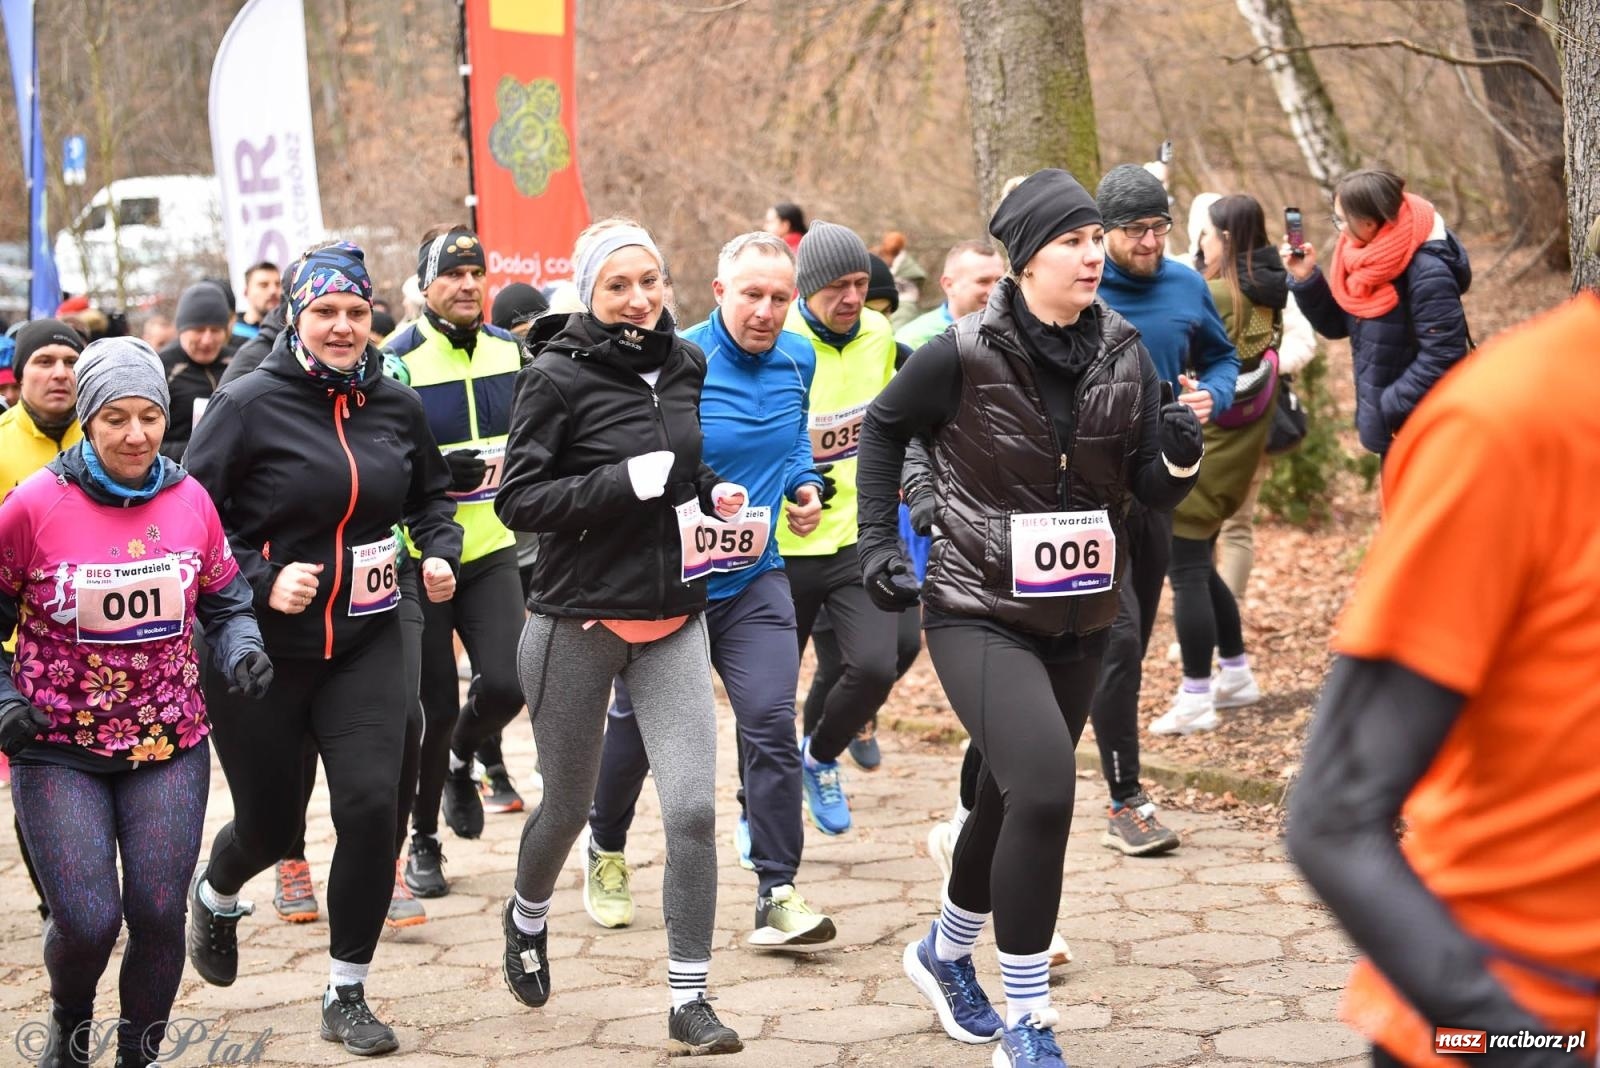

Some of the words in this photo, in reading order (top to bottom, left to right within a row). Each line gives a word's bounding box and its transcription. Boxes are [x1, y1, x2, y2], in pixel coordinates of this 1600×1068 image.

[545, 257, 574, 274] co
[618, 339, 642, 351] adidas
[821, 423, 863, 450] 035
[1022, 517, 1048, 527] BIEG
[360, 547, 377, 558] BIEG
[1034, 539, 1100, 571] 006
[86, 569, 112, 578] BIEG
[114, 562, 171, 578] Twardziela
[366, 563, 397, 593] 06
[102, 588, 161, 621] 001
